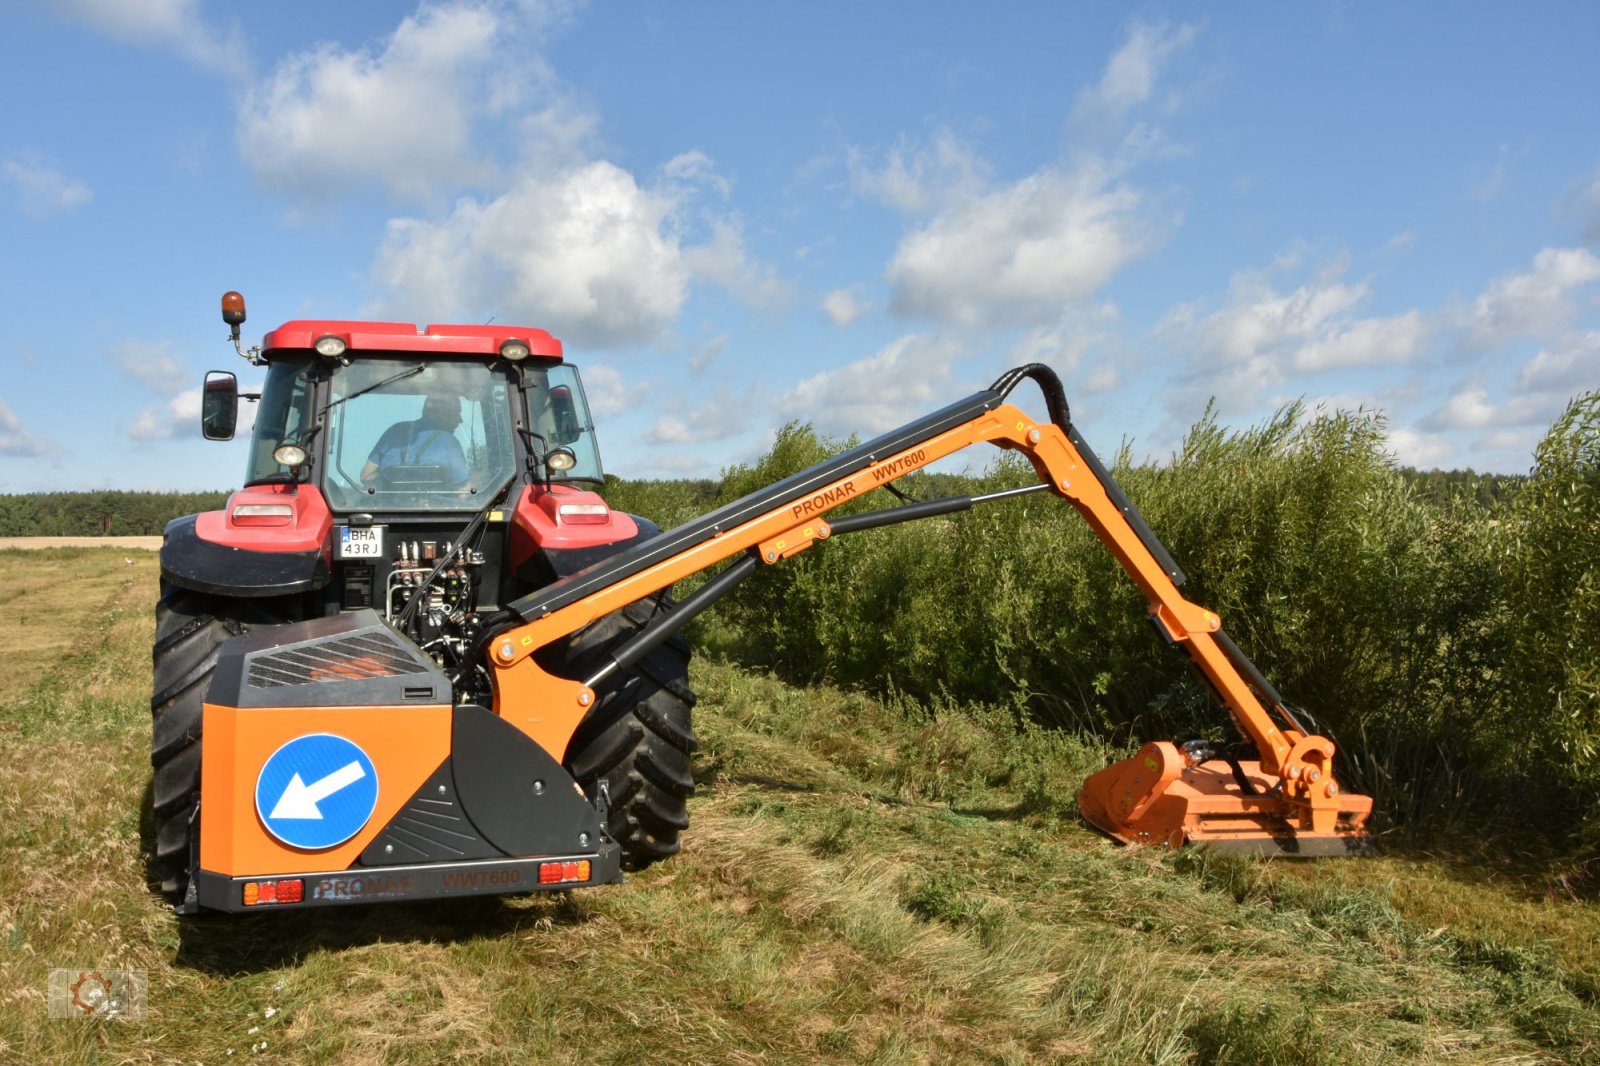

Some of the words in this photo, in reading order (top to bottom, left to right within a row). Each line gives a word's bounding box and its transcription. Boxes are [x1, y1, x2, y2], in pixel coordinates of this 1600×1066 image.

[792, 481, 856, 519] PRONAR
[872, 449, 926, 481] WWT600
[351, 530, 376, 541] BHA
[344, 543, 378, 554] 43RJ
[442, 869, 521, 888] WWT600
